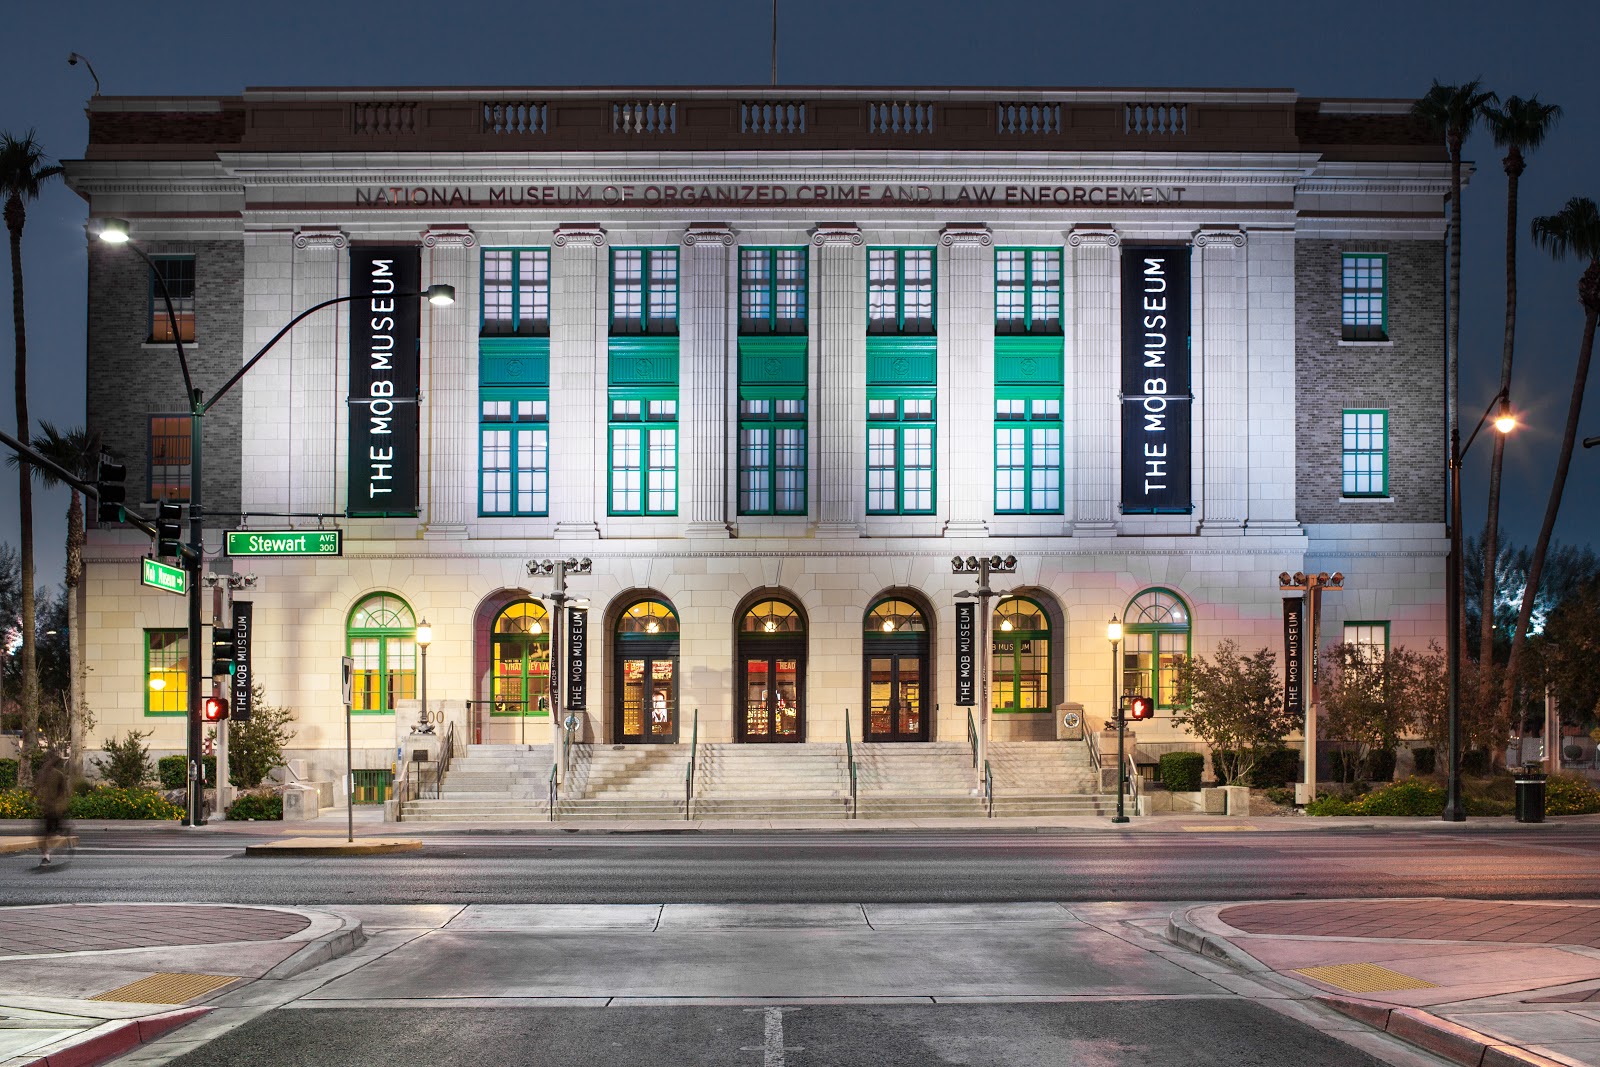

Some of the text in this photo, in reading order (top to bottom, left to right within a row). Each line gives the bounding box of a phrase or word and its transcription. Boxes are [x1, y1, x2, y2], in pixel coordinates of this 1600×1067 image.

[356, 186, 1187, 206] NATIONAL MUSEUM OF ORGANIZED CRIME AND LAW ENFORCEMENT
[370, 259, 394, 499] THE MOB MUSEUM
[1144, 258, 1167, 495] THE MOB MUSEUM
[158, 566, 176, 588] Museum
[230, 534, 335, 552] E Stewart AVE
[320, 544, 335, 552] 300
[237, 616, 247, 712] THE MOB MUSEUM
[573, 611, 583, 707] THE MOB MUSEUM
[960, 607, 971, 702] THE MOB MUSEUM
[998, 643, 1030, 651] MUSUM
[1289, 612, 1298, 707] THE MOB MUSEUM
